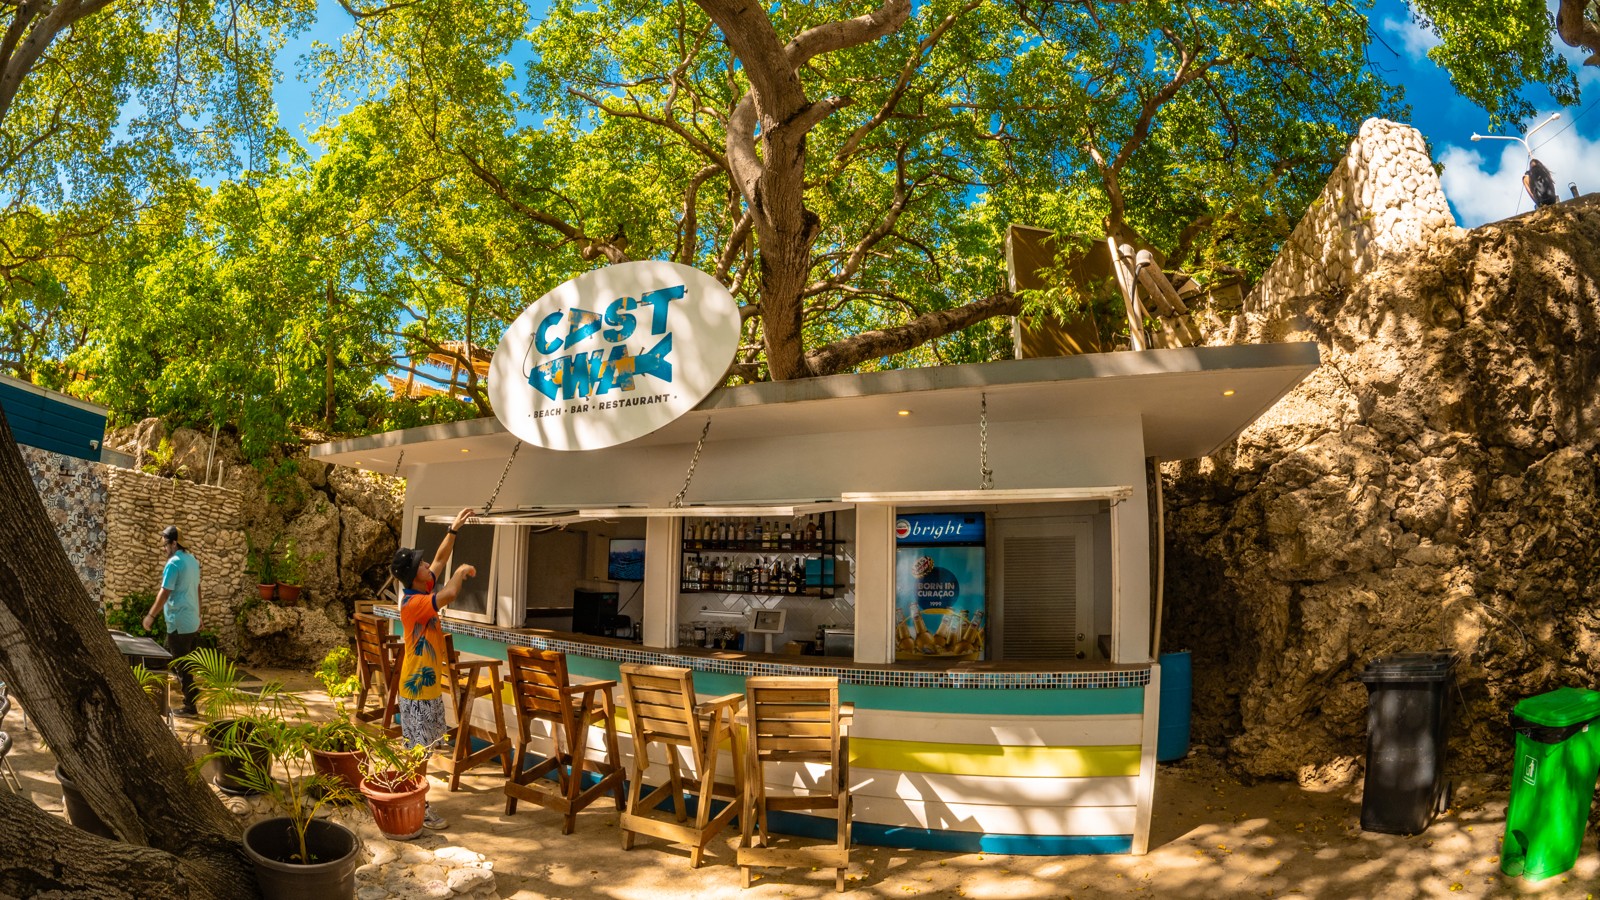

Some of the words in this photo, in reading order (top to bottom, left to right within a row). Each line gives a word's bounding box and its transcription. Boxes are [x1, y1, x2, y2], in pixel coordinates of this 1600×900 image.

[535, 285, 684, 355] CAST
[533, 408, 561, 419] BEACH
[570, 404, 589, 414] BAR
[599, 394, 669, 410] RESTAURANT
[913, 521, 963, 539] bright
[918, 590, 955, 599] CURAÇAO
